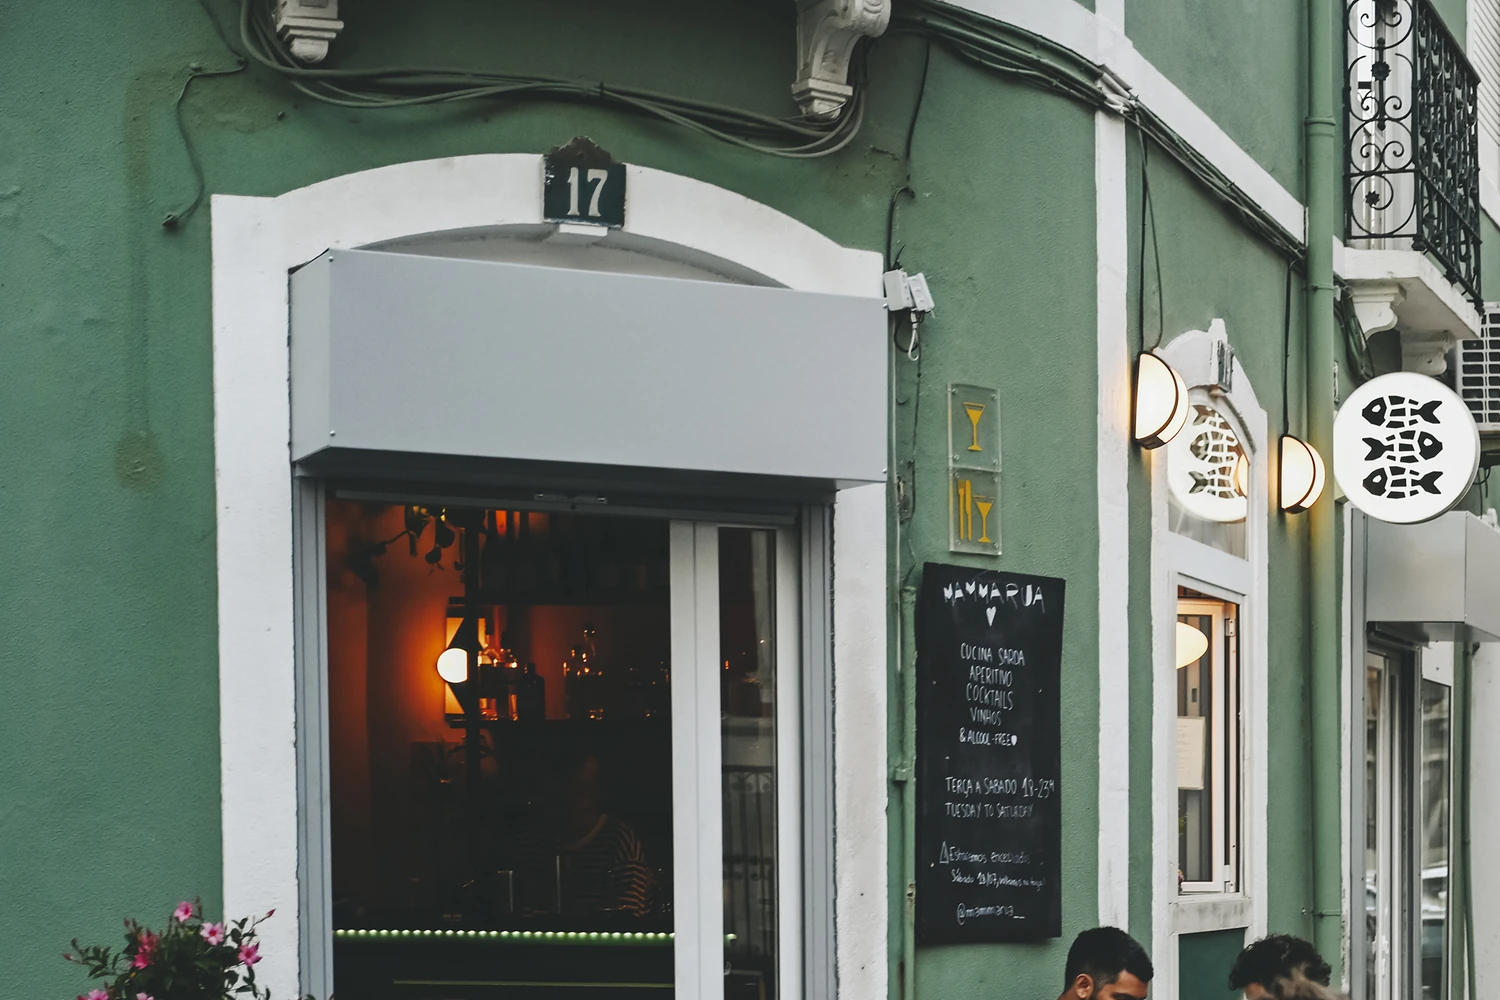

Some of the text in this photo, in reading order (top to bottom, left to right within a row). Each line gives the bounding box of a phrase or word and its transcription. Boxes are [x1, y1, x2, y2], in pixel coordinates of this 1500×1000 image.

[566, 166, 609, 217] 17
[960, 642, 1026, 666] CUCINA SARDA
[966, 682, 1014, 711] COCKTAILS
[969, 706, 1002, 726] VINHOS
[945, 802, 982, 818] TUESDAY
